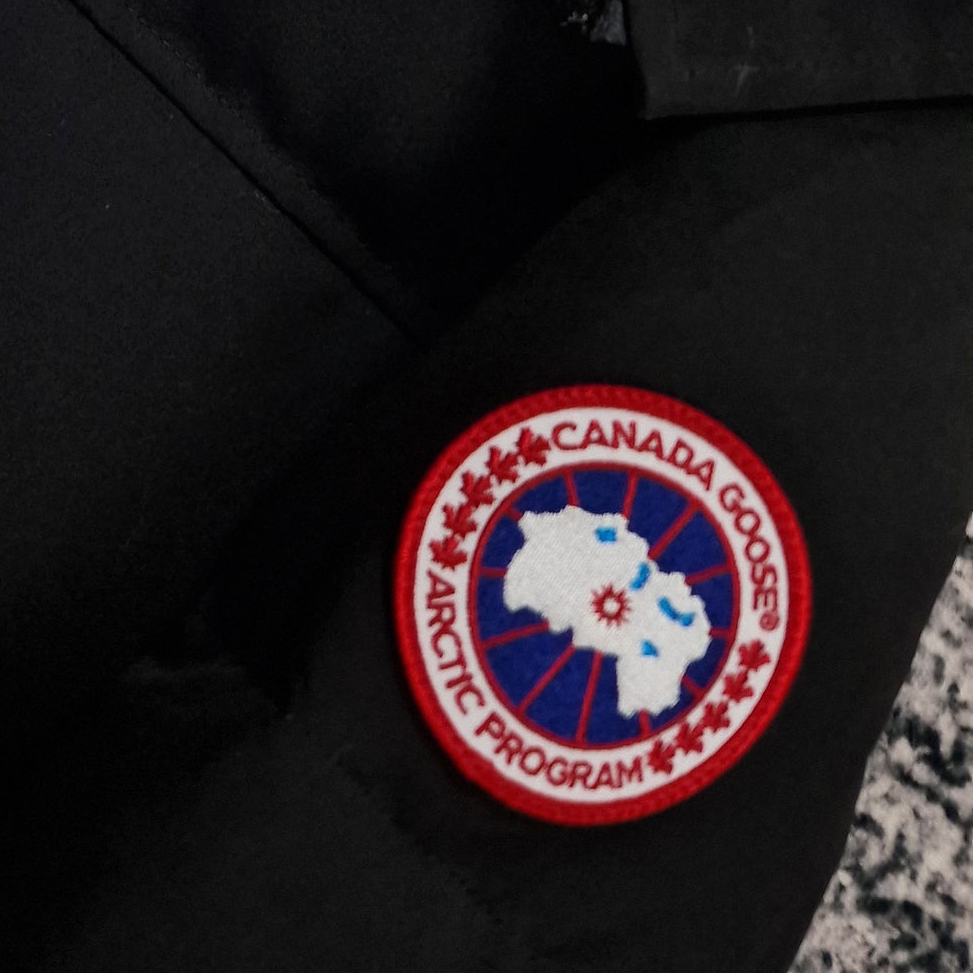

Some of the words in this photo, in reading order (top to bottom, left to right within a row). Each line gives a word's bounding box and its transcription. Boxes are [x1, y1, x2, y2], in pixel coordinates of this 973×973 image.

[551, 420, 716, 492] CANADA
[426, 570, 487, 717] ARCTIC
[475, 713, 645, 790] PROGRAM
